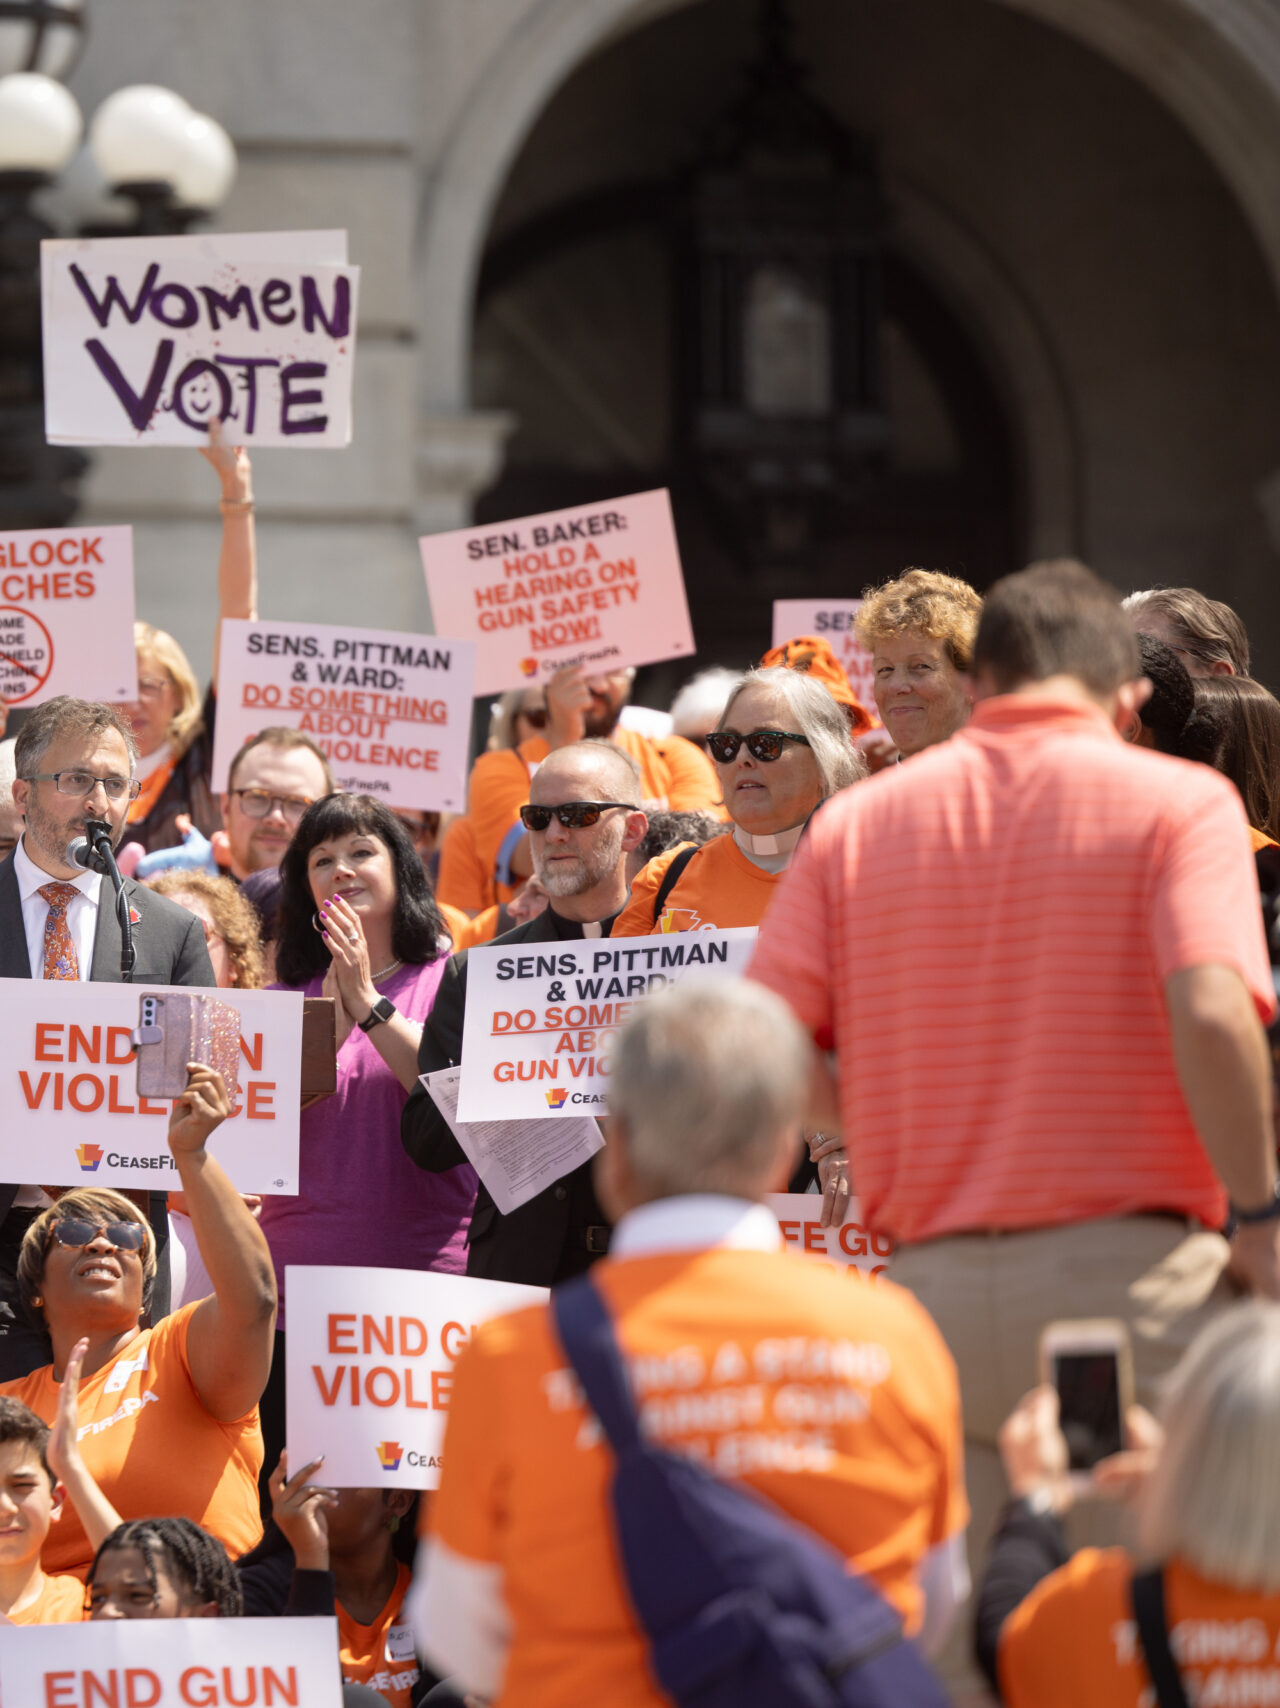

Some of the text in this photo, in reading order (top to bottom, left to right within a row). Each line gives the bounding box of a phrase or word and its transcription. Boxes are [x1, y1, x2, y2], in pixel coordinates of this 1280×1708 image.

[84, 338, 328, 434] VOTE
[467, 511, 629, 560] SEN. BAKER:
[503, 542, 601, 579] HOLD A
[475, 557, 637, 609] HEARING ON
[478, 581, 640, 633] GUN SAFETY
[247, 633, 451, 671] SENS. PITTMAN
[529, 615, 602, 650] NOW!
[291, 661, 404, 691] & WARD:
[242, 683, 447, 722] DO SOMETHING
[298, 712, 392, 741] ABOUT
[496, 941, 728, 981] SENS. PITTMAN
[546, 981, 566, 1003] &
[492, 1002, 634, 1033] DO SOME
[35, 1023, 137, 1065] END
[554, 1029, 617, 1054] ABO
[493, 1059, 559, 1083] GUN
[778, 1220, 895, 1258] FE GU
[327, 1313, 428, 1357] END
[312, 1366, 454, 1411] VIOLE
[76, 1390, 159, 1442] FIREPA
[44, 1667, 162, 1708] END
[179, 1666, 297, 1708] GUN
